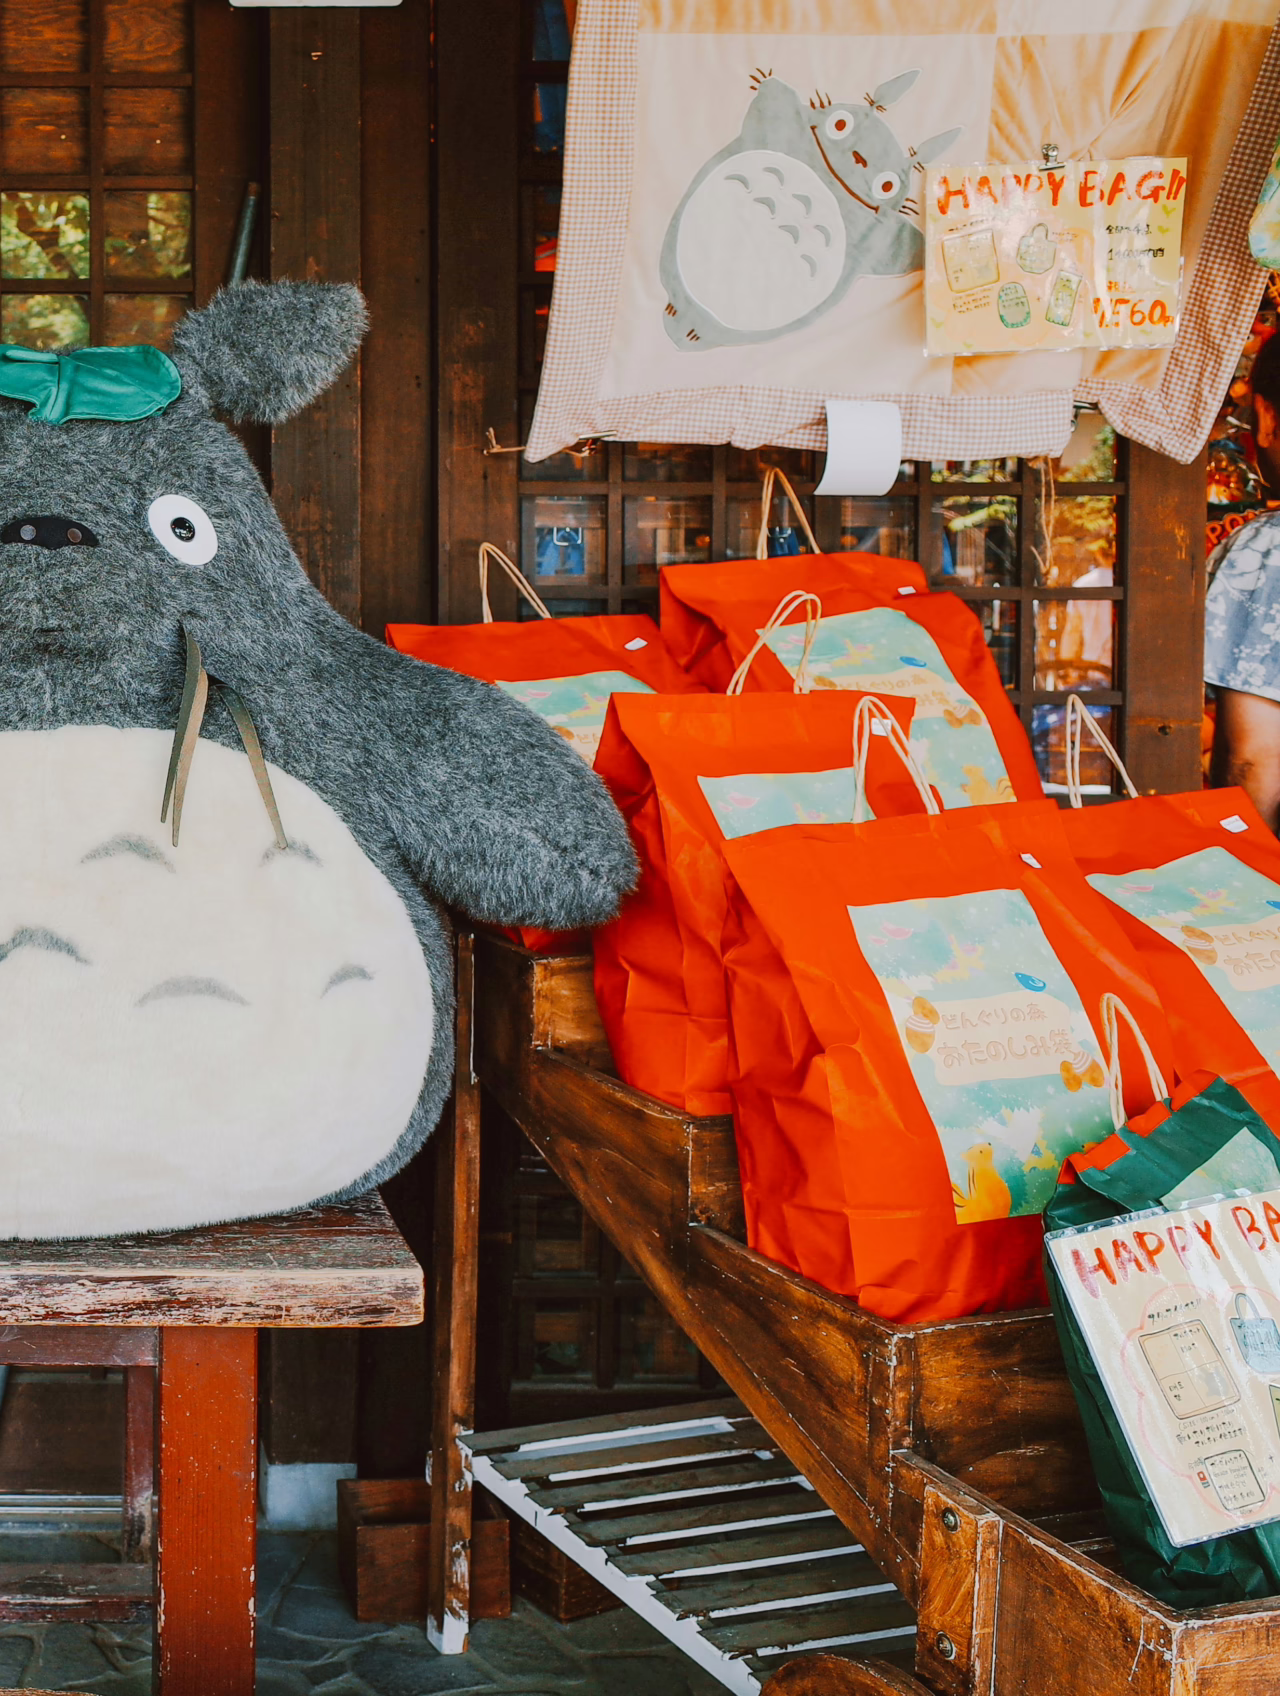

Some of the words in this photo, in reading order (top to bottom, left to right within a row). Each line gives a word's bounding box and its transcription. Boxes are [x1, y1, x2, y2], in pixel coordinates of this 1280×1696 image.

[937, 171, 1066, 215] HAPPY
[941, 1002, 1048, 1030] どんぐりの森
[1071, 1219, 1221, 1300] HAPPY
